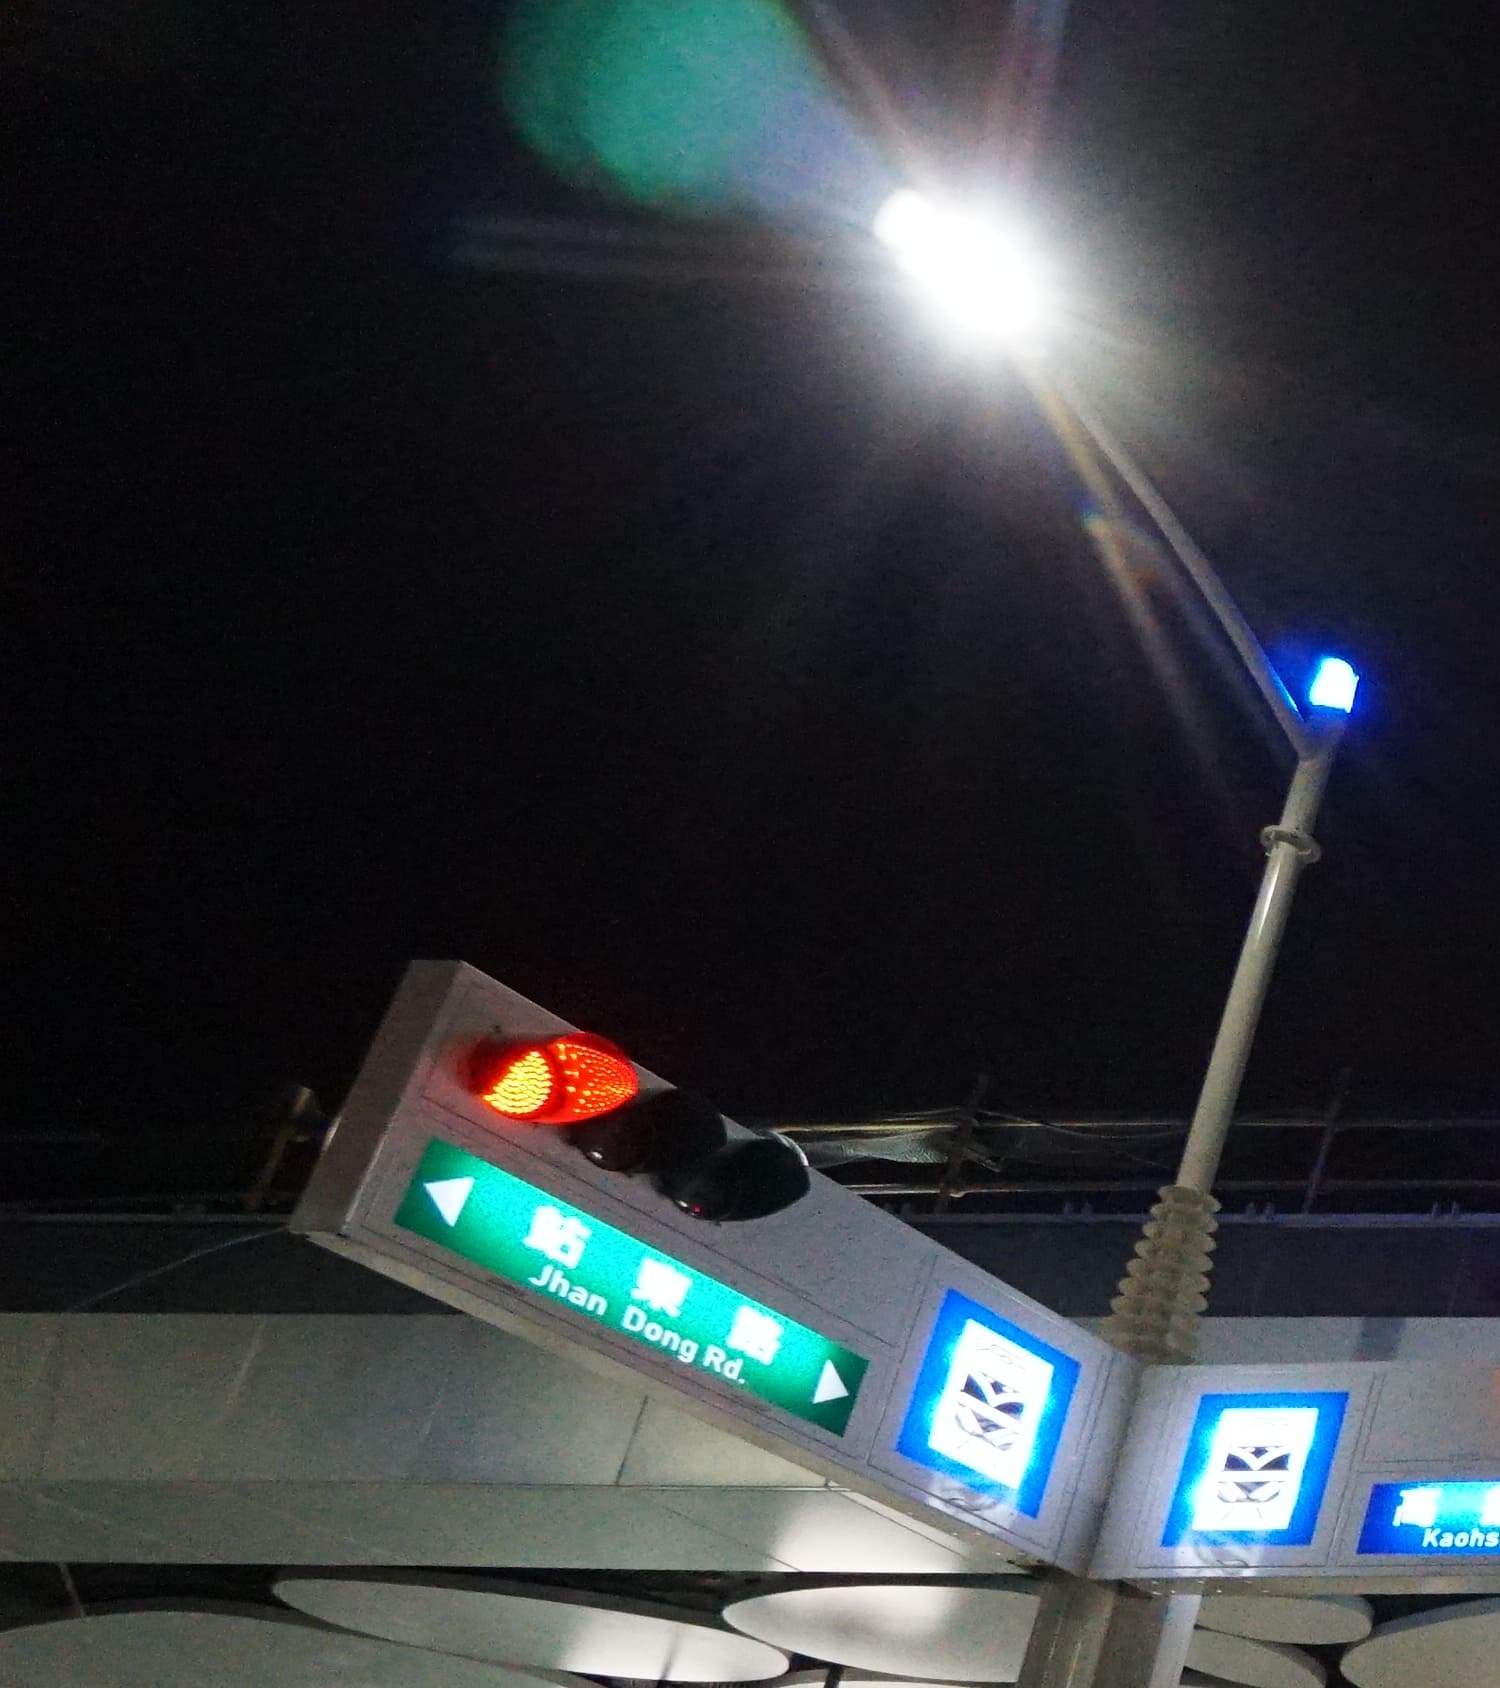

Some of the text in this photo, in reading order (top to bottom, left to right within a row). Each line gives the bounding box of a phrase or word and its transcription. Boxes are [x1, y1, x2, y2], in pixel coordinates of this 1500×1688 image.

[529, 1265, 746, 1385] Jhan Dong Rd.
